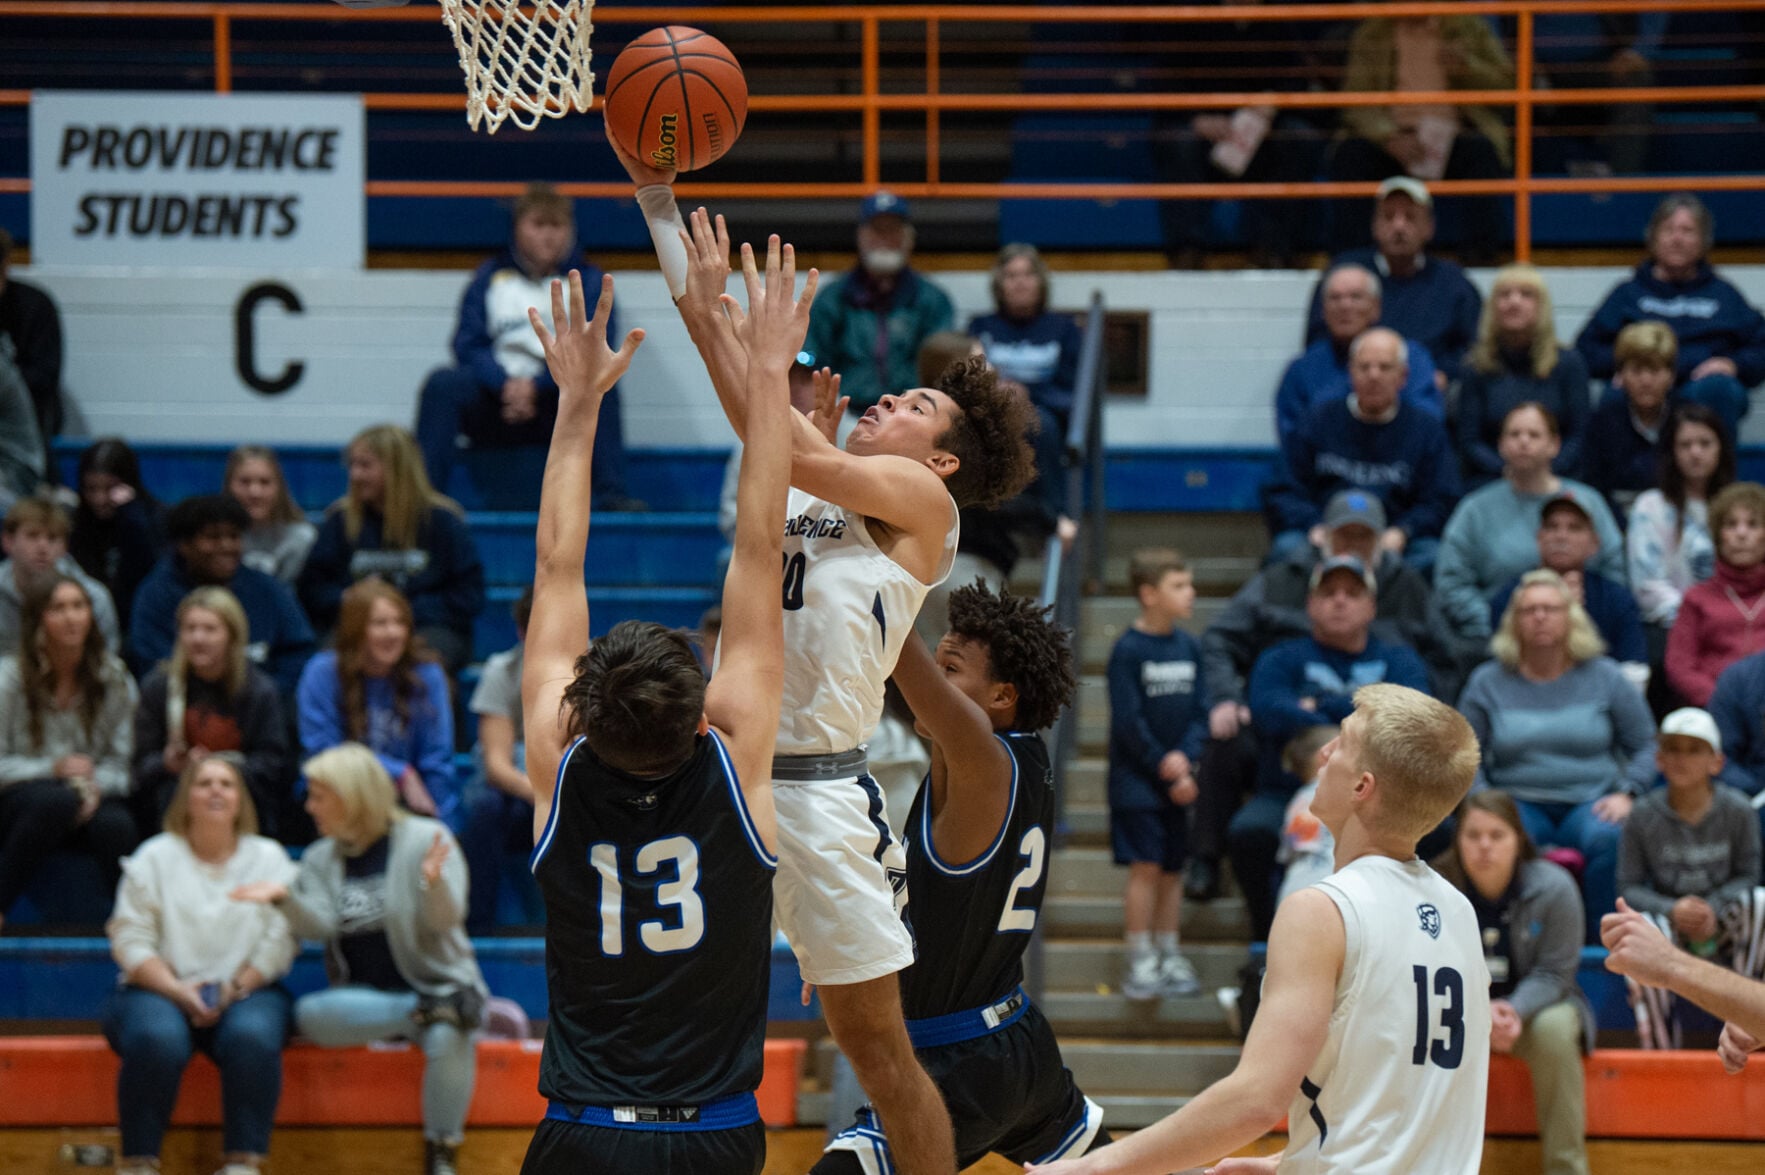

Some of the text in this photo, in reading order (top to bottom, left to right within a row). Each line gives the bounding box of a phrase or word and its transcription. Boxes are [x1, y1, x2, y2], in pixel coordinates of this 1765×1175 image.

[58, 125, 340, 171] PROVIDENCE
[73, 193, 300, 238] STUDENTS
[234, 280, 304, 395] C
[782, 551, 806, 612] 0
[588, 833, 706, 957] 13
[996, 824, 1046, 934] 2
[1412, 964, 1465, 1070] 13
